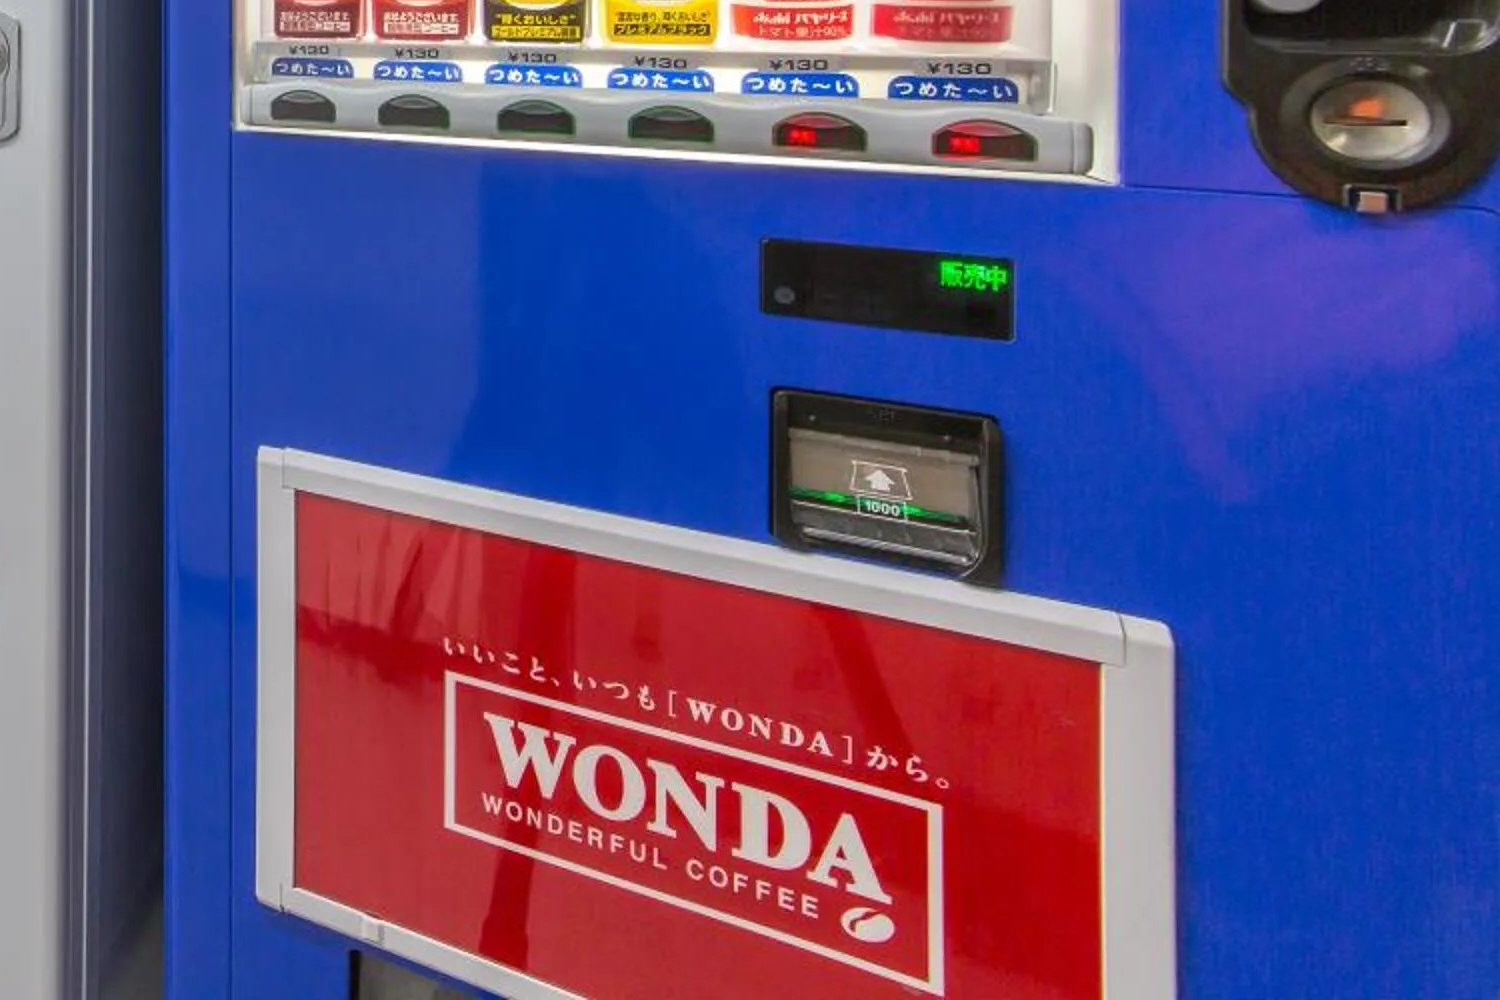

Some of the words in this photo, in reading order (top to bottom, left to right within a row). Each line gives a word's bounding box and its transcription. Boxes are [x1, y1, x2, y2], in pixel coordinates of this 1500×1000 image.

[289, 44, 329, 56] ¥130
[395, 47, 439, 60] ¥130
[508, 51, 557, 64] ¥130
[635, 55, 687, 69] ¥130
[769, 58, 829, 71] ¥130
[928, 62, 992, 76] ¥130
[940, 260, 1008, 292] 販売中
[864, 500, 901, 518] 1000
[483, 711, 893, 906] WONDA
[481, 791, 668, 872] WONDERFUL
[686, 857, 821, 921] COFFEE
